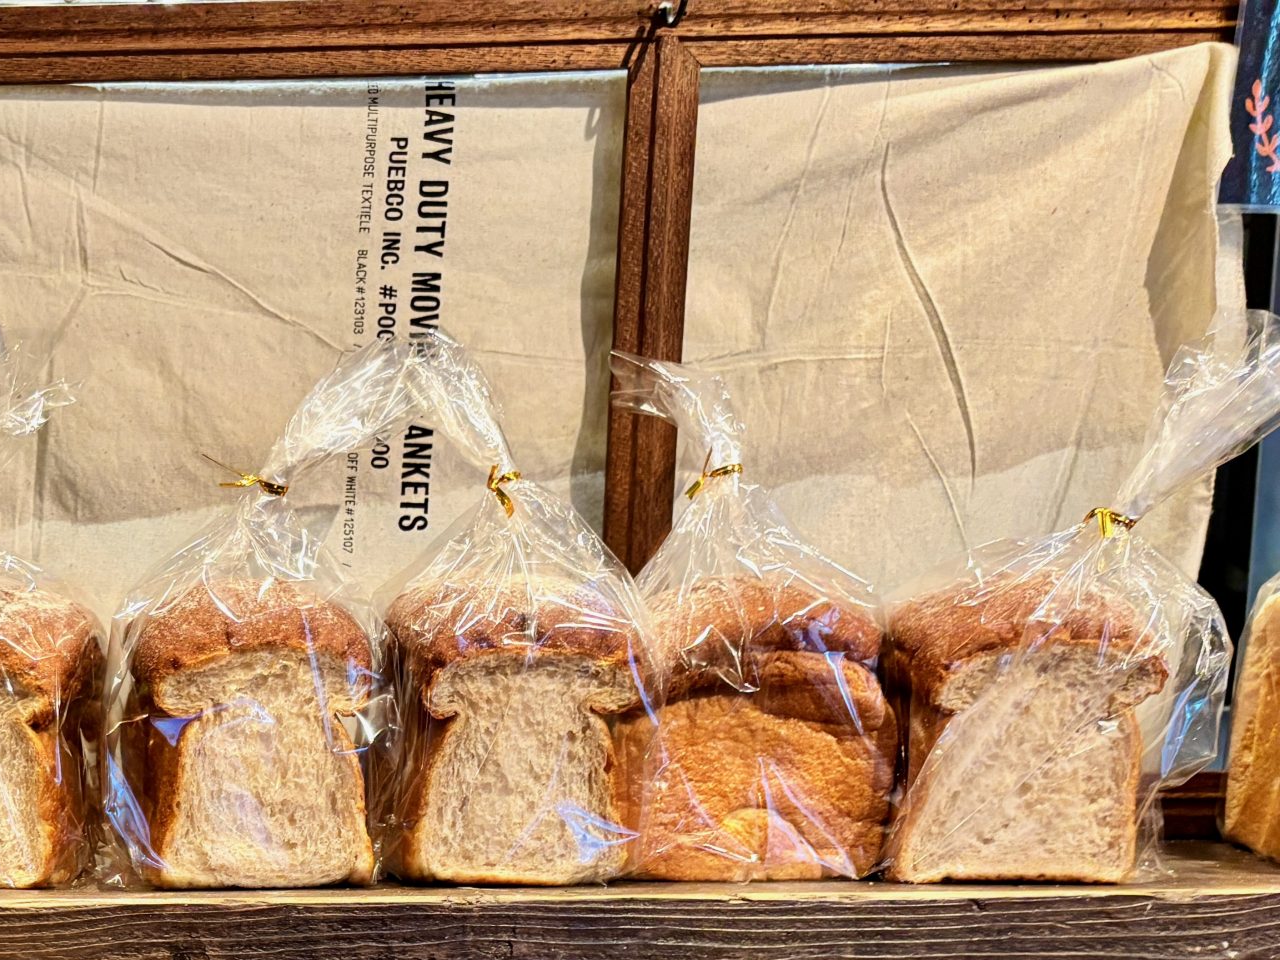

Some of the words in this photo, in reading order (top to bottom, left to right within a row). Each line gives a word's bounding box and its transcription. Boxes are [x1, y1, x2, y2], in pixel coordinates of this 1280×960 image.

[363, 97, 379, 178] MULTIPURPOSE
[422, 81, 456, 165] HEAVY
[357, 183, 373, 234] TEXTIELE
[384, 137, 409, 222] PUEBCO
[380, 231, 402, 272] INC.
[415, 180, 449, 257] DUTY
[347, 452, 359, 472] OFF
